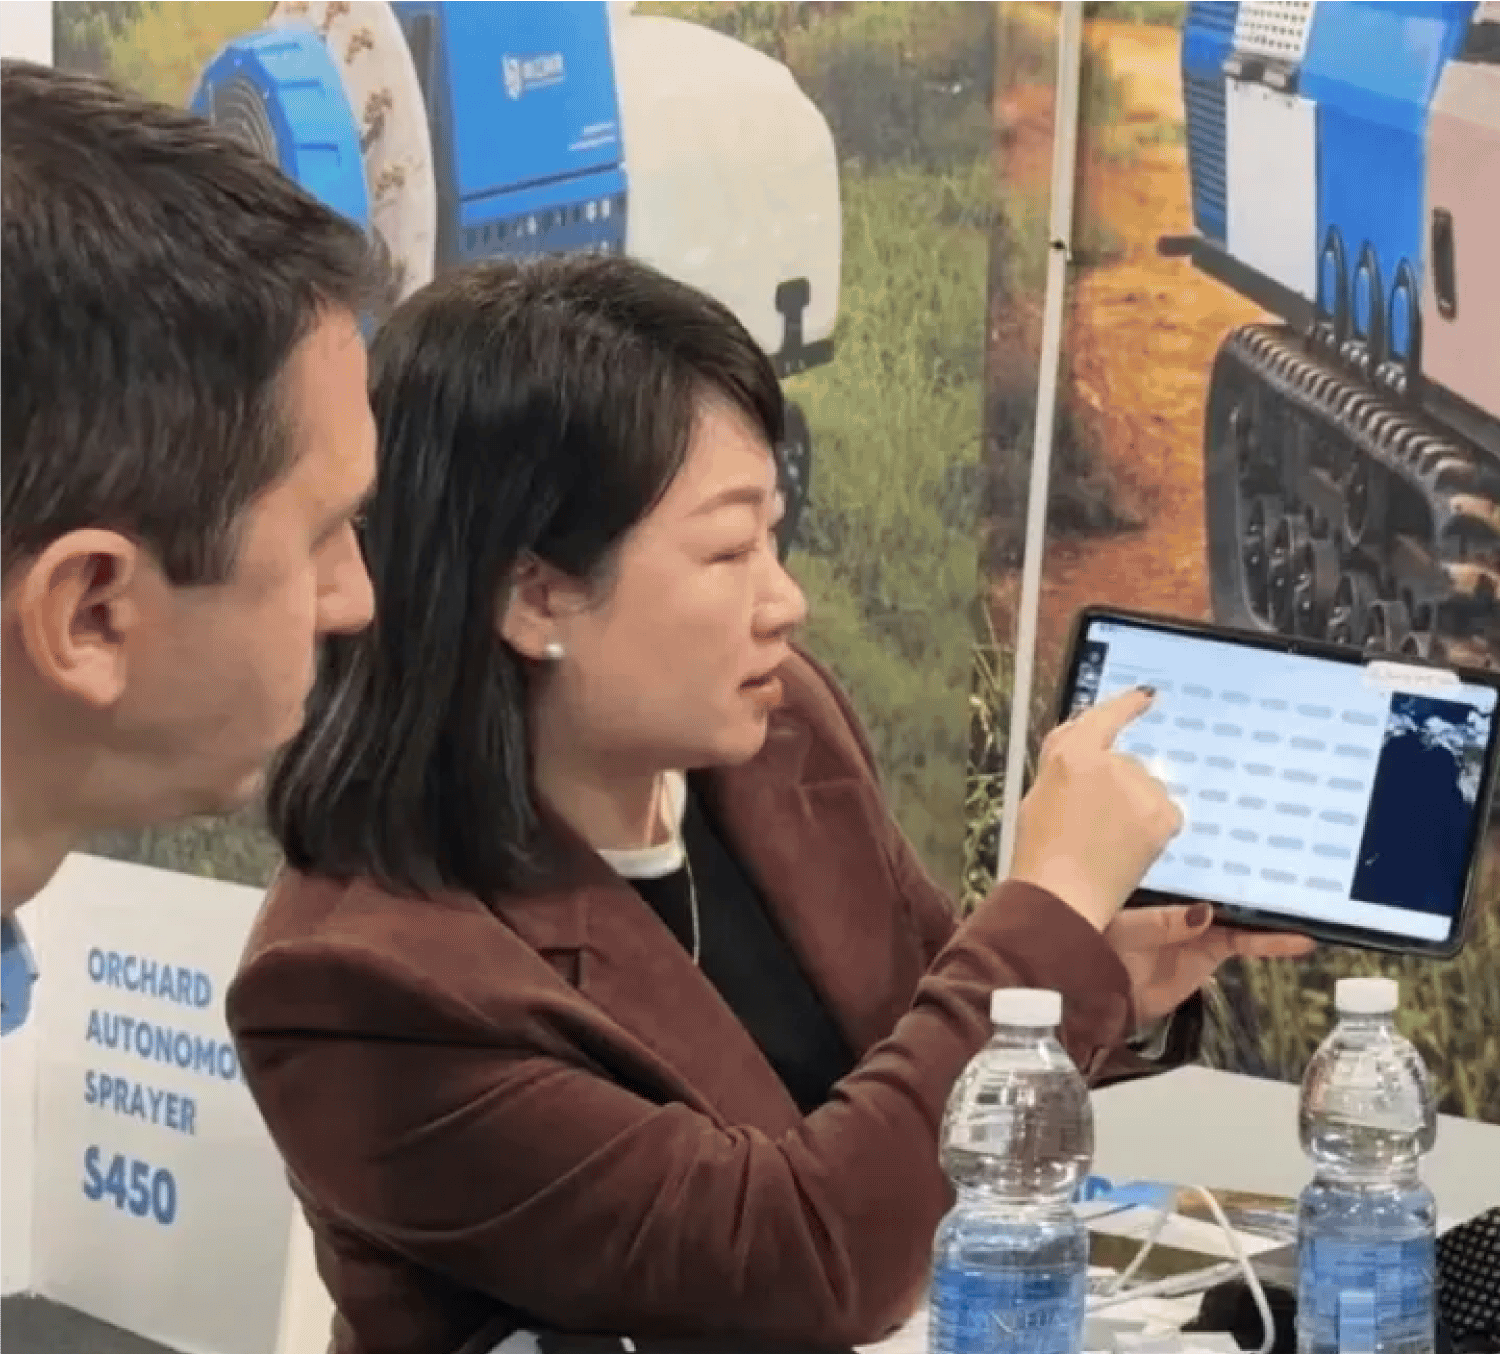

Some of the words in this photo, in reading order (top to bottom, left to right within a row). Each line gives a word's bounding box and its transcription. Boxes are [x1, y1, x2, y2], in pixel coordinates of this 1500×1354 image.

[87, 947, 212, 1009] ORCHARD
[86, 1008, 236, 1081] AUTONOMO
[84, 1068, 197, 1136] SPRAYER
[82, 1143, 177, 1226] S450
